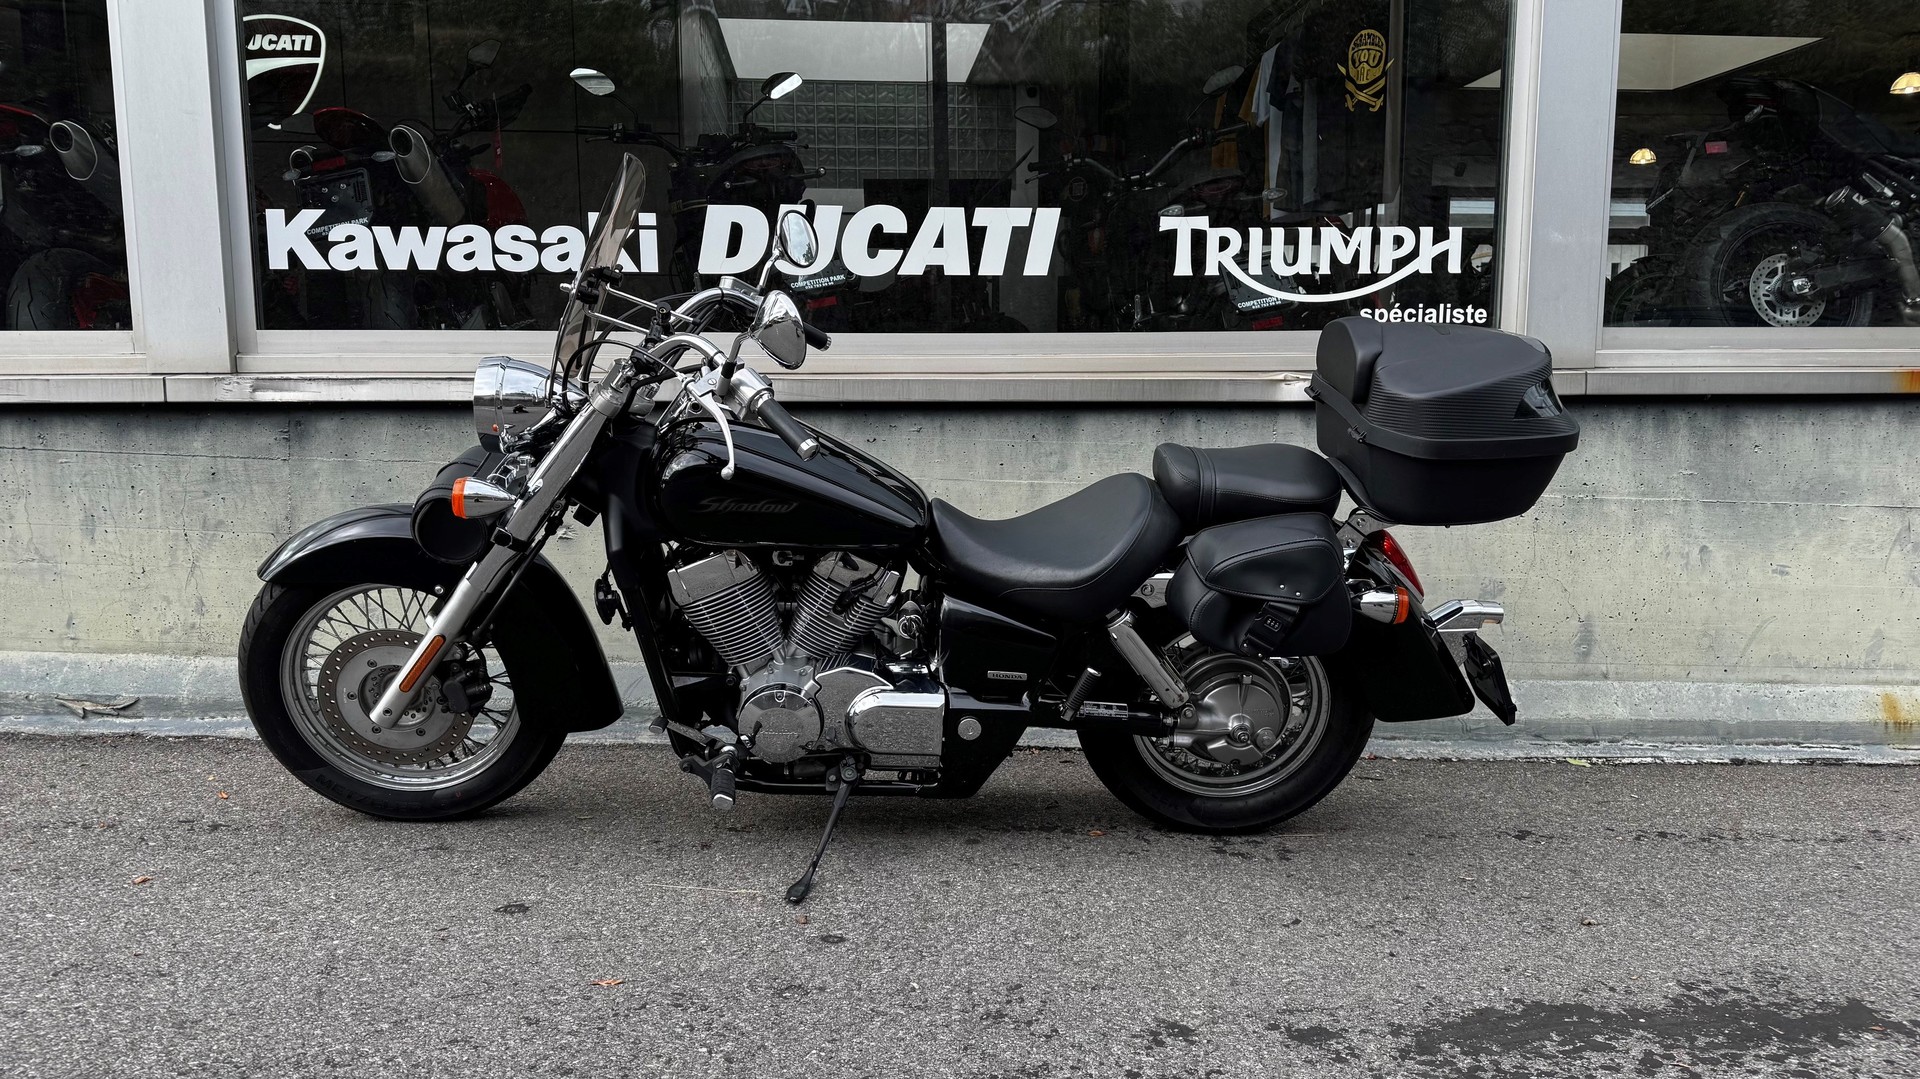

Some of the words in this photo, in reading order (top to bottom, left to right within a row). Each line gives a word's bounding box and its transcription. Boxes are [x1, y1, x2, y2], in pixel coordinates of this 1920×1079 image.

[246, 34, 313, 51] UCATI
[1353, 50, 1380, 67] YOU
[266, 208, 658, 272] Kawasaki
[698, 204, 1061, 276] DUCATI
[1159, 216, 1462, 302] TRIUMPH
[790, 277, 829, 288] COMPETITION
[830, 274, 846, 282] PARK
[1238, 297, 1277, 308] COMPETITION
[1360, 303, 1487, 323] spécialiste
[697, 496, 799, 514] Shadow
